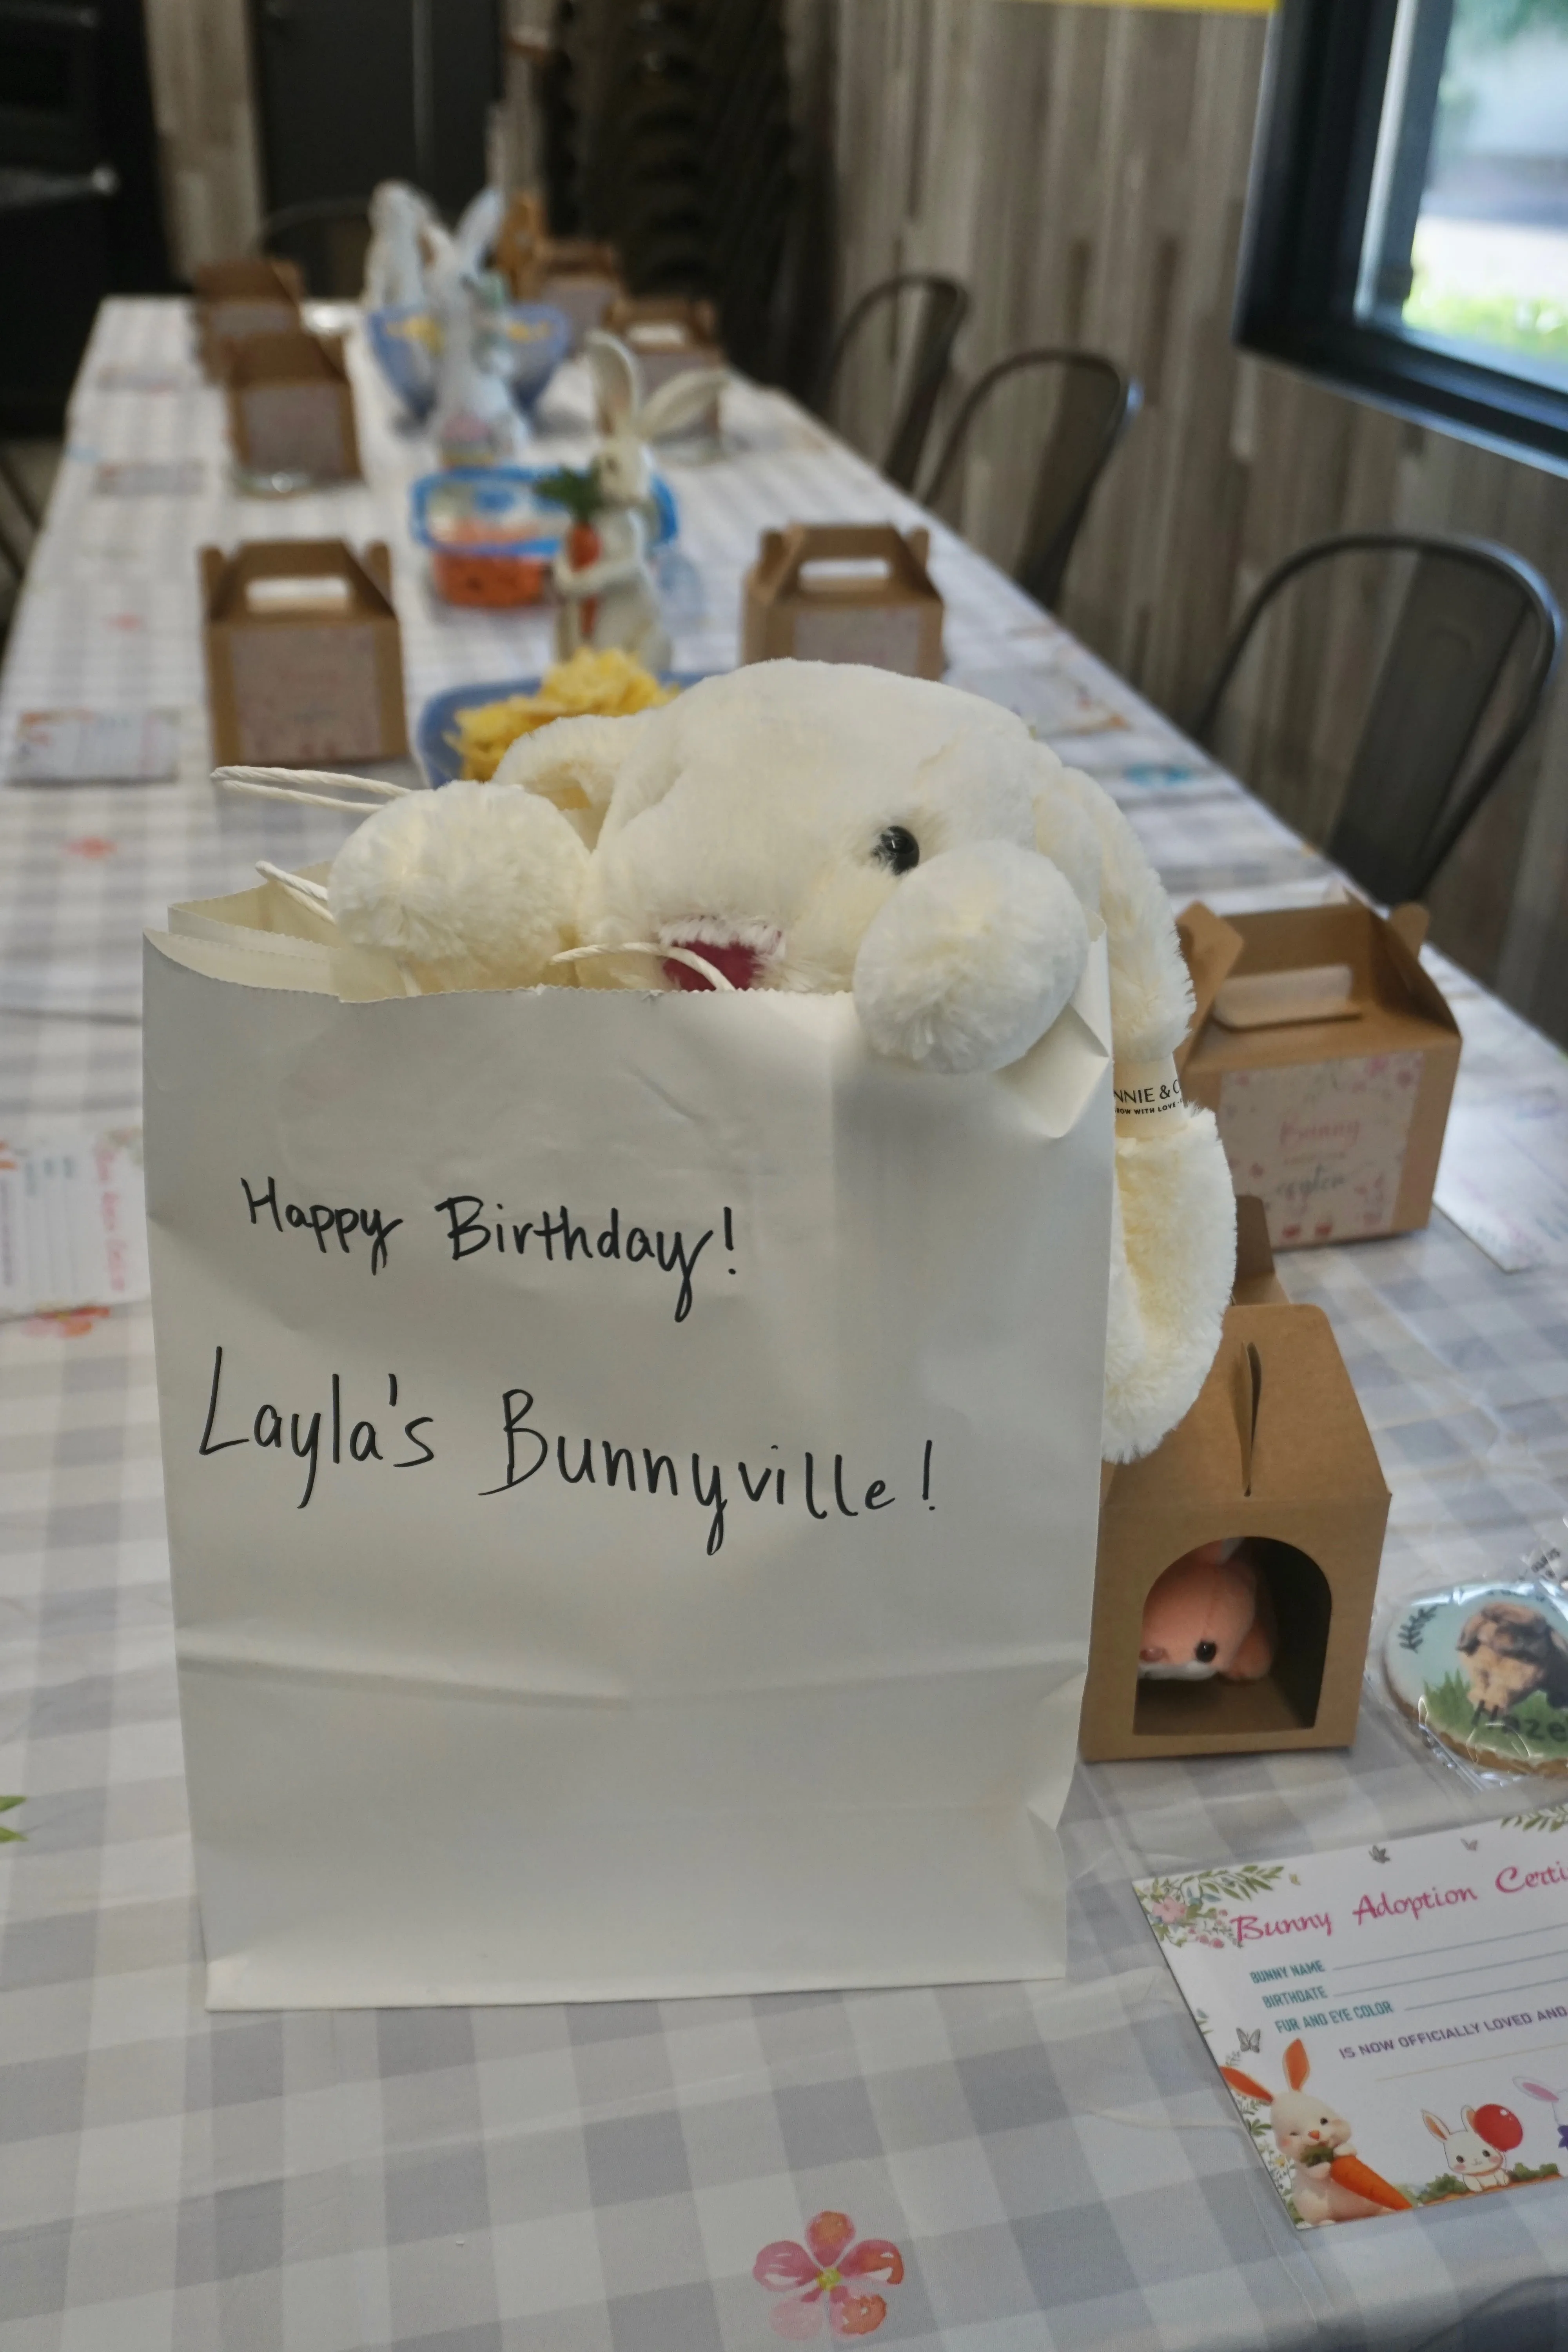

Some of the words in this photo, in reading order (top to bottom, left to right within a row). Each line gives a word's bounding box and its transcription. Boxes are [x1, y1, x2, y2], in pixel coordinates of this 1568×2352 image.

[1158, 1102, 1176, 1112] LOVE
[1160, 1085, 1170, 1099] &
[241, 1176, 403, 1276] Happy
[434, 1196, 736, 1323] Birthday!
[199, 1346, 434, 1509] Layla's
[1230, 1911, 1332, 1942] Bunny
[1352, 1886, 1477, 1926] Adoption
[1495, 1860, 1568, 1894] Certi
[1250, 1967, 1289, 1984] BUNNY
[1290, 1960, 1326, 1977] NAME
[1261, 1985, 1328, 2008] BIRTHDATE
[1274, 2018, 1300, 2033] FUR
[1303, 2013, 1328, 2028] AND
[1328, 2007, 1353, 2024] EYE
[1353, 2000, 1394, 2019] COLOR
[1339, 2046, 1356, 2060] IS
[1358, 2039, 1395, 2056] NOW
[1397, 2022, 1481, 2048] OFFICIALLY
[1483, 2012, 1533, 2032] LOVED
[1537, 2005, 1567, 2021] AND
